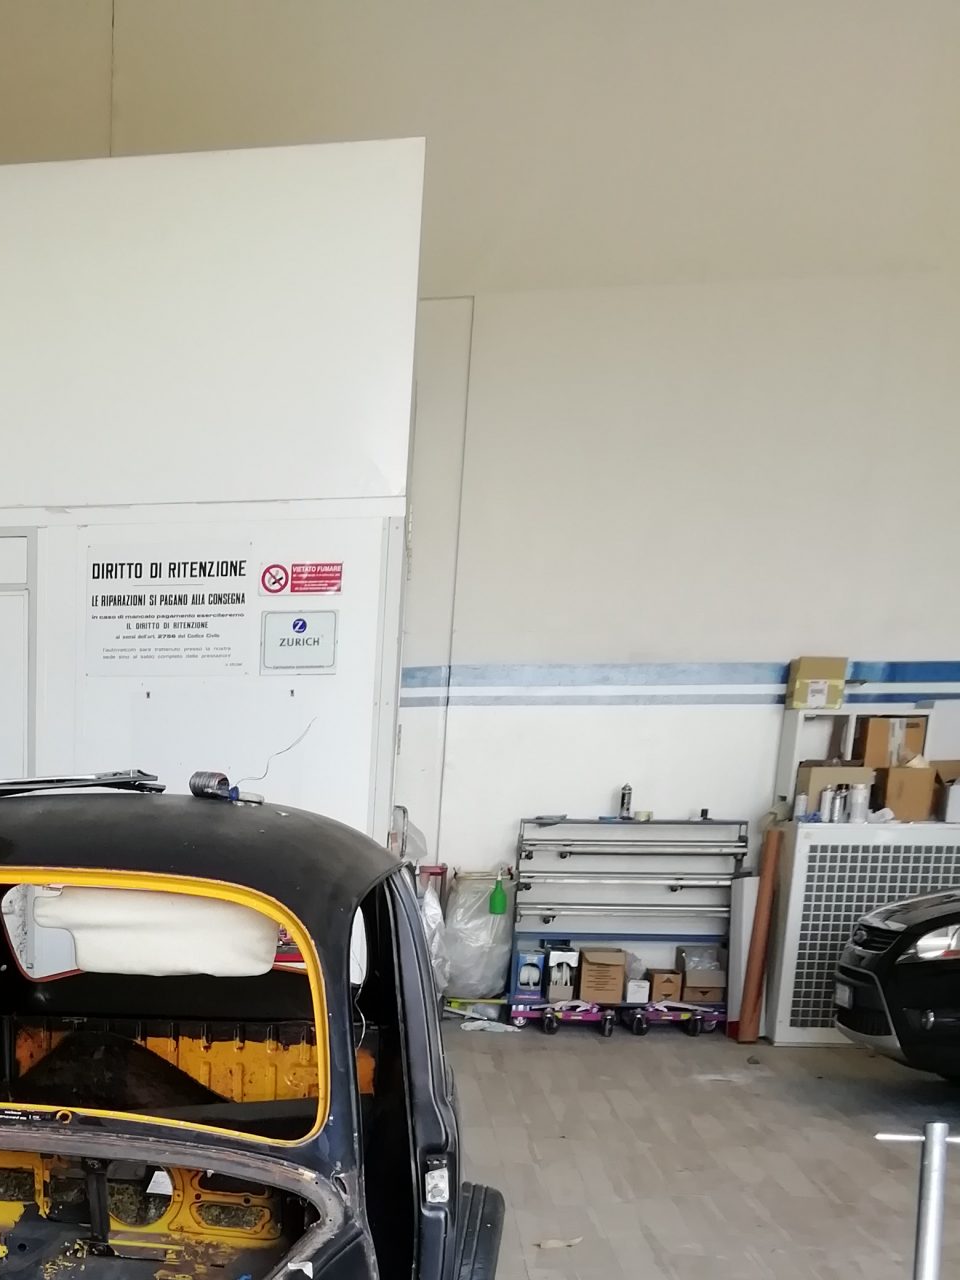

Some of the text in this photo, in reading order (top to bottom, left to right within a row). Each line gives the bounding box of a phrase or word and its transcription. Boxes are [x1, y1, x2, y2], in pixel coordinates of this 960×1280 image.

[92, 559, 247, 580] DIRITTO DI RITENZIONE
[292, 564, 342, 573] VIETATO FUMARE
[91, 592, 246, 607] LE RIPARAZIONI SI PAGANO ALLA CONSEGNA
[126, 621, 209, 630] IL DIRITTO DI RITENZIONE
[279, 637, 320, 647] ZURICH
